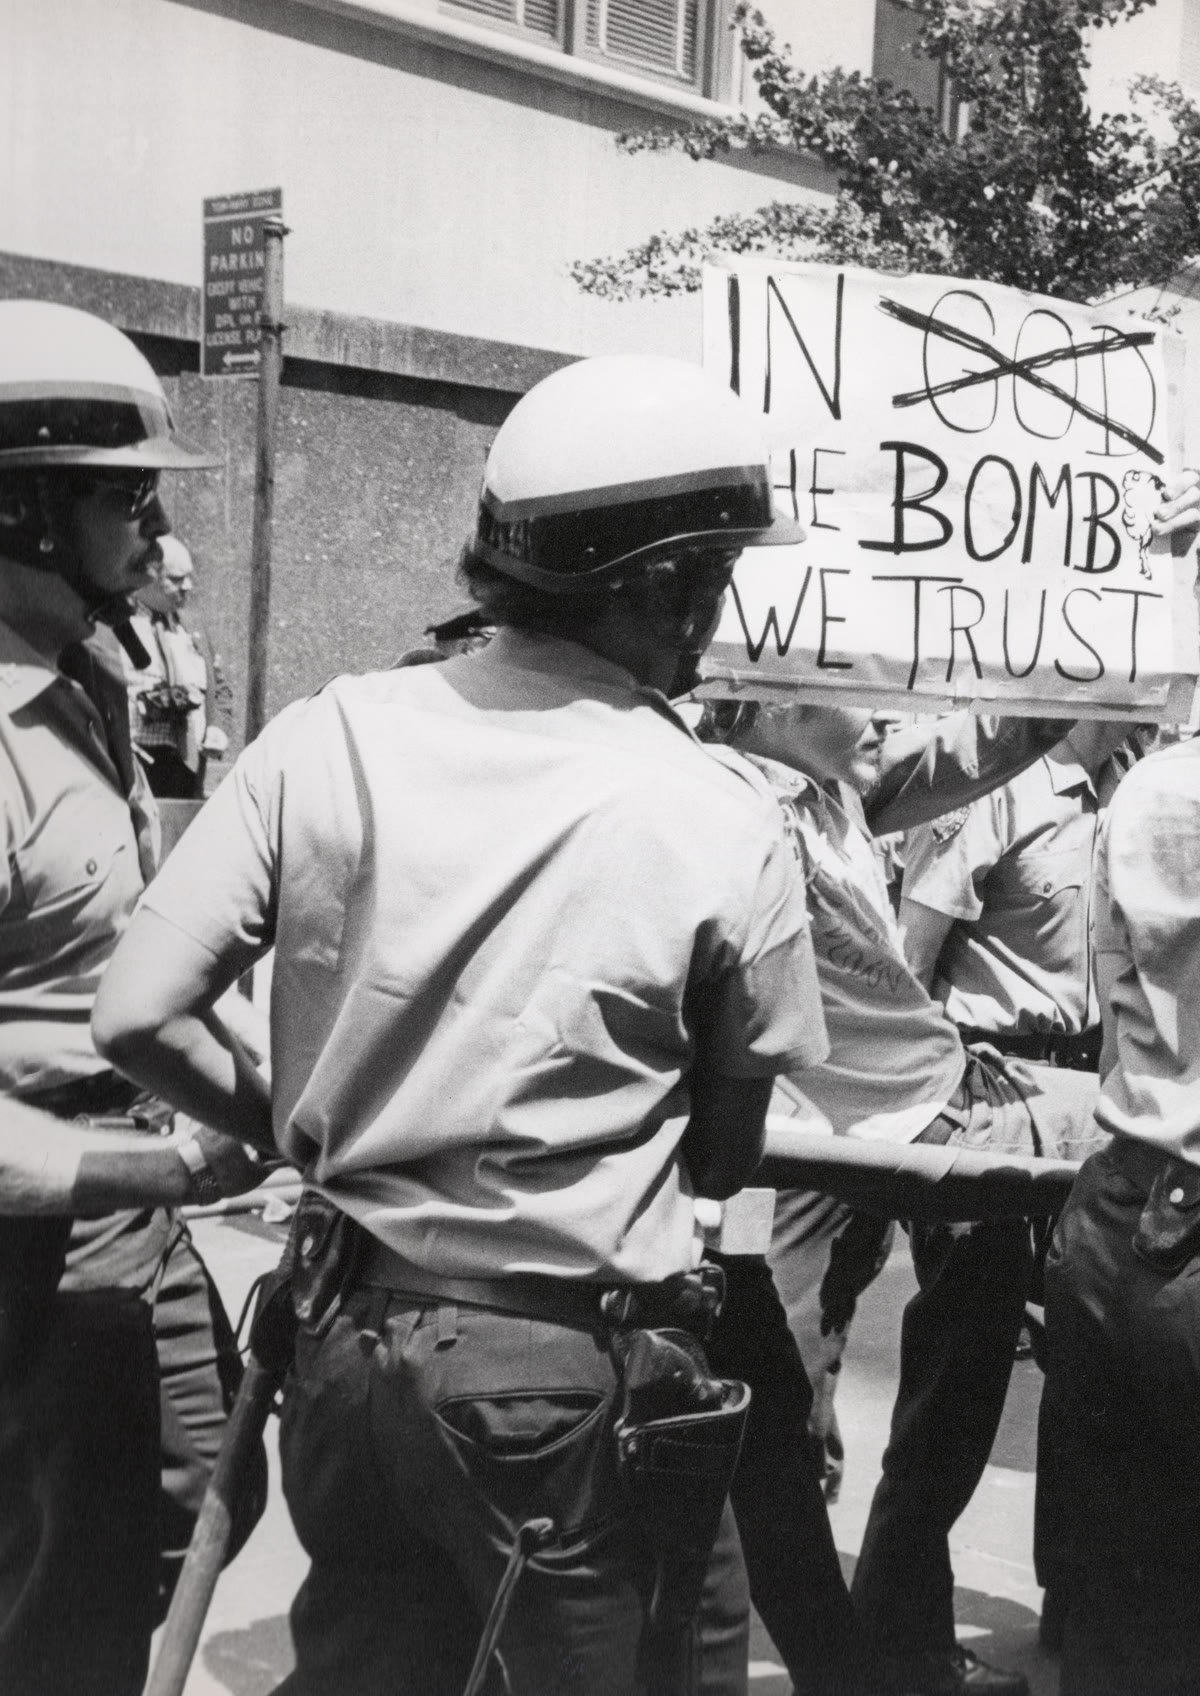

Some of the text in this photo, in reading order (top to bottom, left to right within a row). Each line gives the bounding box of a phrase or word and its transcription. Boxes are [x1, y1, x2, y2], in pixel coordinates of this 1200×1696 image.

[209, 250, 265, 273] PARKIN
[231, 225, 255, 246] NO
[238, 277, 264, 294] VEHIC
[727, 273, 1156, 457] IN GOD
[769, 441, 1124, 575] HE BOMB
[729, 566, 1164, 690] WE TRUST
